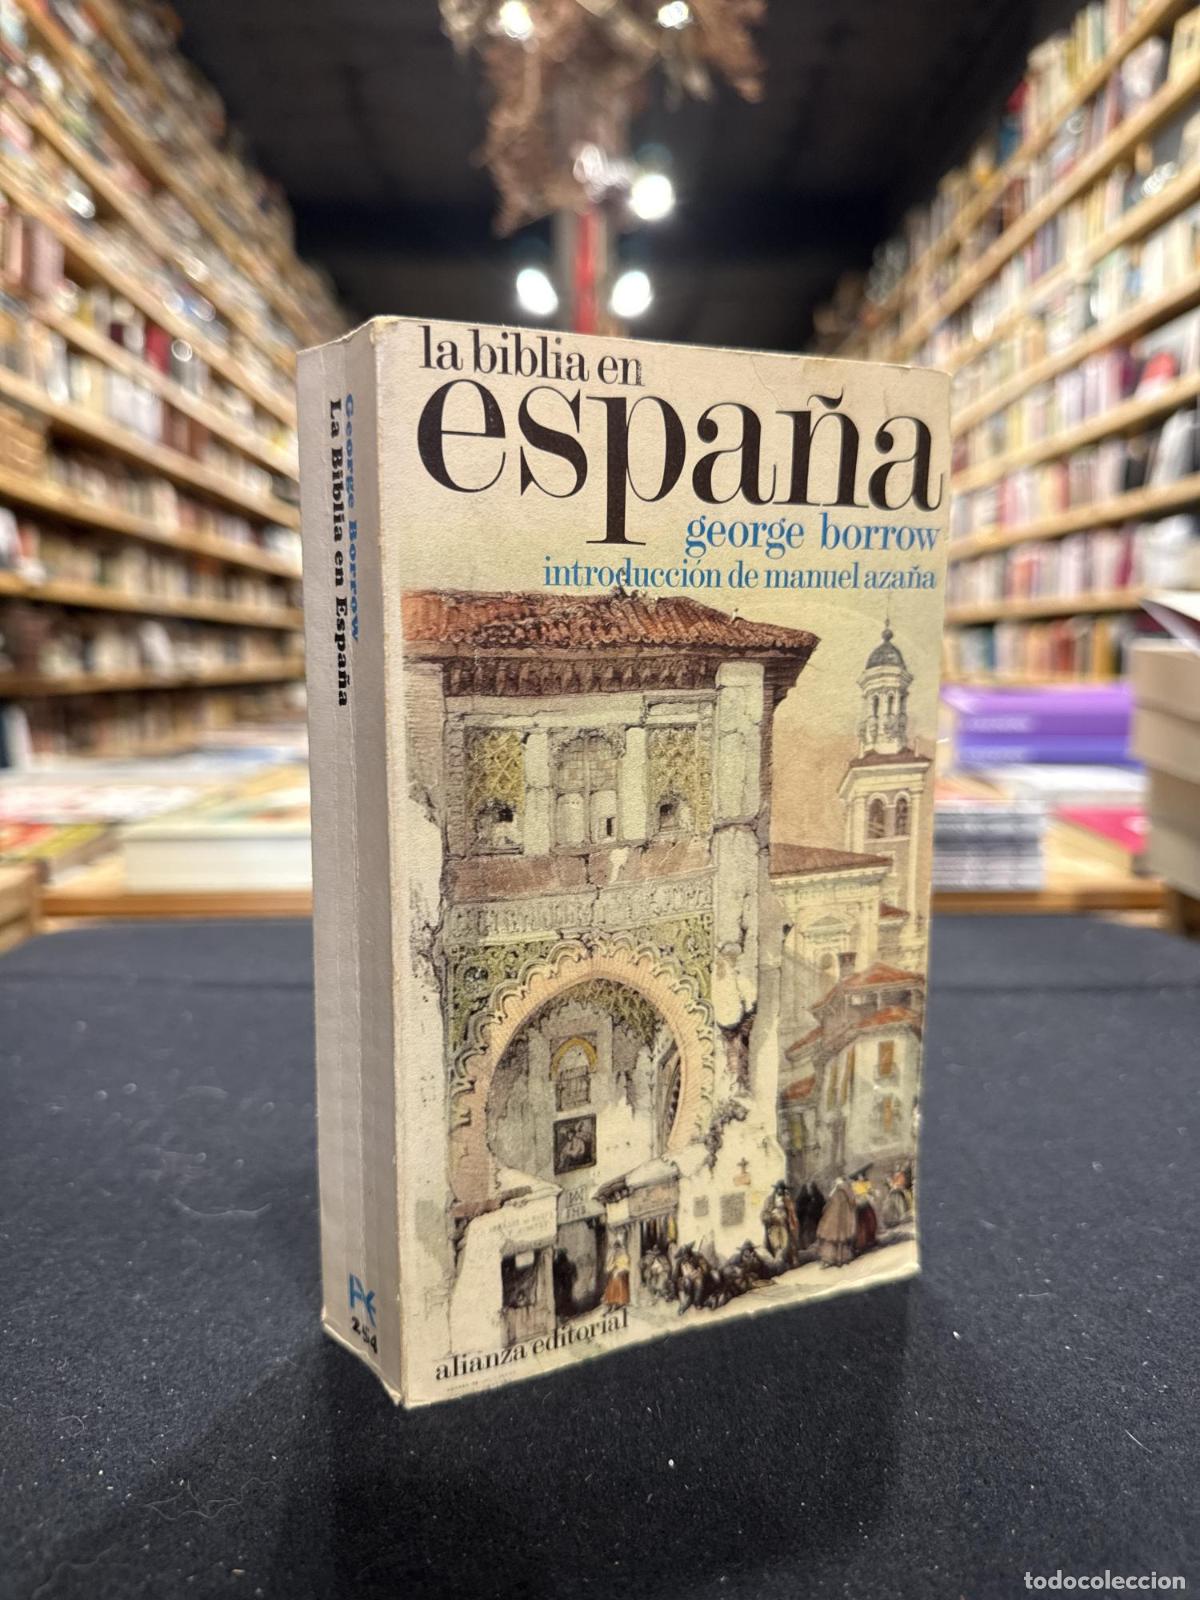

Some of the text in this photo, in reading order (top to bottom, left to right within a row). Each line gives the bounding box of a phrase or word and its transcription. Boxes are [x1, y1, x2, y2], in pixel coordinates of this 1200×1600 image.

[419, 325, 646, 387] la biblia en
[417, 378, 944, 546] españa
[330, 398, 351, 707] La Biblia en España
[345, 393, 359, 642] George Borrow
[685, 512, 942, 558] george borrow
[543, 555, 937, 591] introducción de manuel azaña
[435, 1346, 528, 1381] alianza
[533, 1308, 630, 1355] editorial
